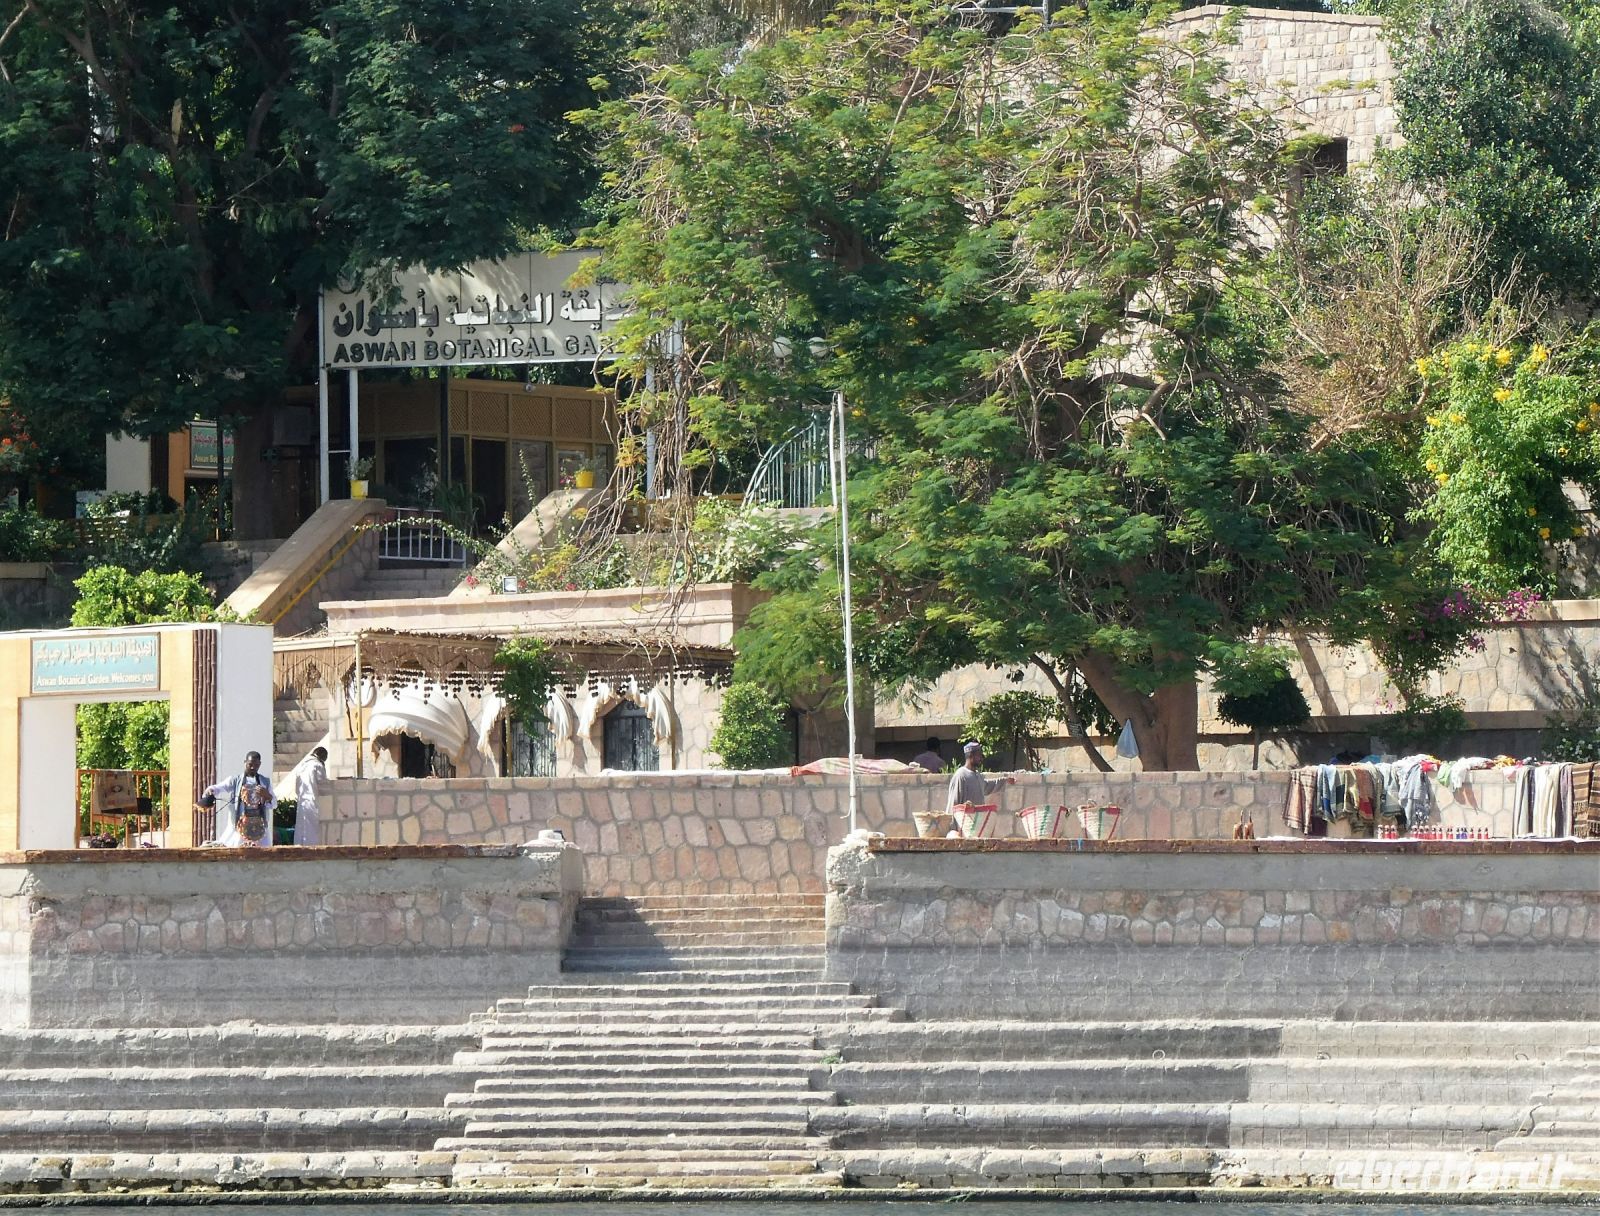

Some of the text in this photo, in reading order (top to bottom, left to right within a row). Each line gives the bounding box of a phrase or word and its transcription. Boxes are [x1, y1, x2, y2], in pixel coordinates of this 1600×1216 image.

[446, 292, 554, 334] النباتية
[333, 334, 629, 363] ASWAN BOTANICAL GAR
[36, 671, 154, 686] Aswan Botanical Garden Welcomes you
